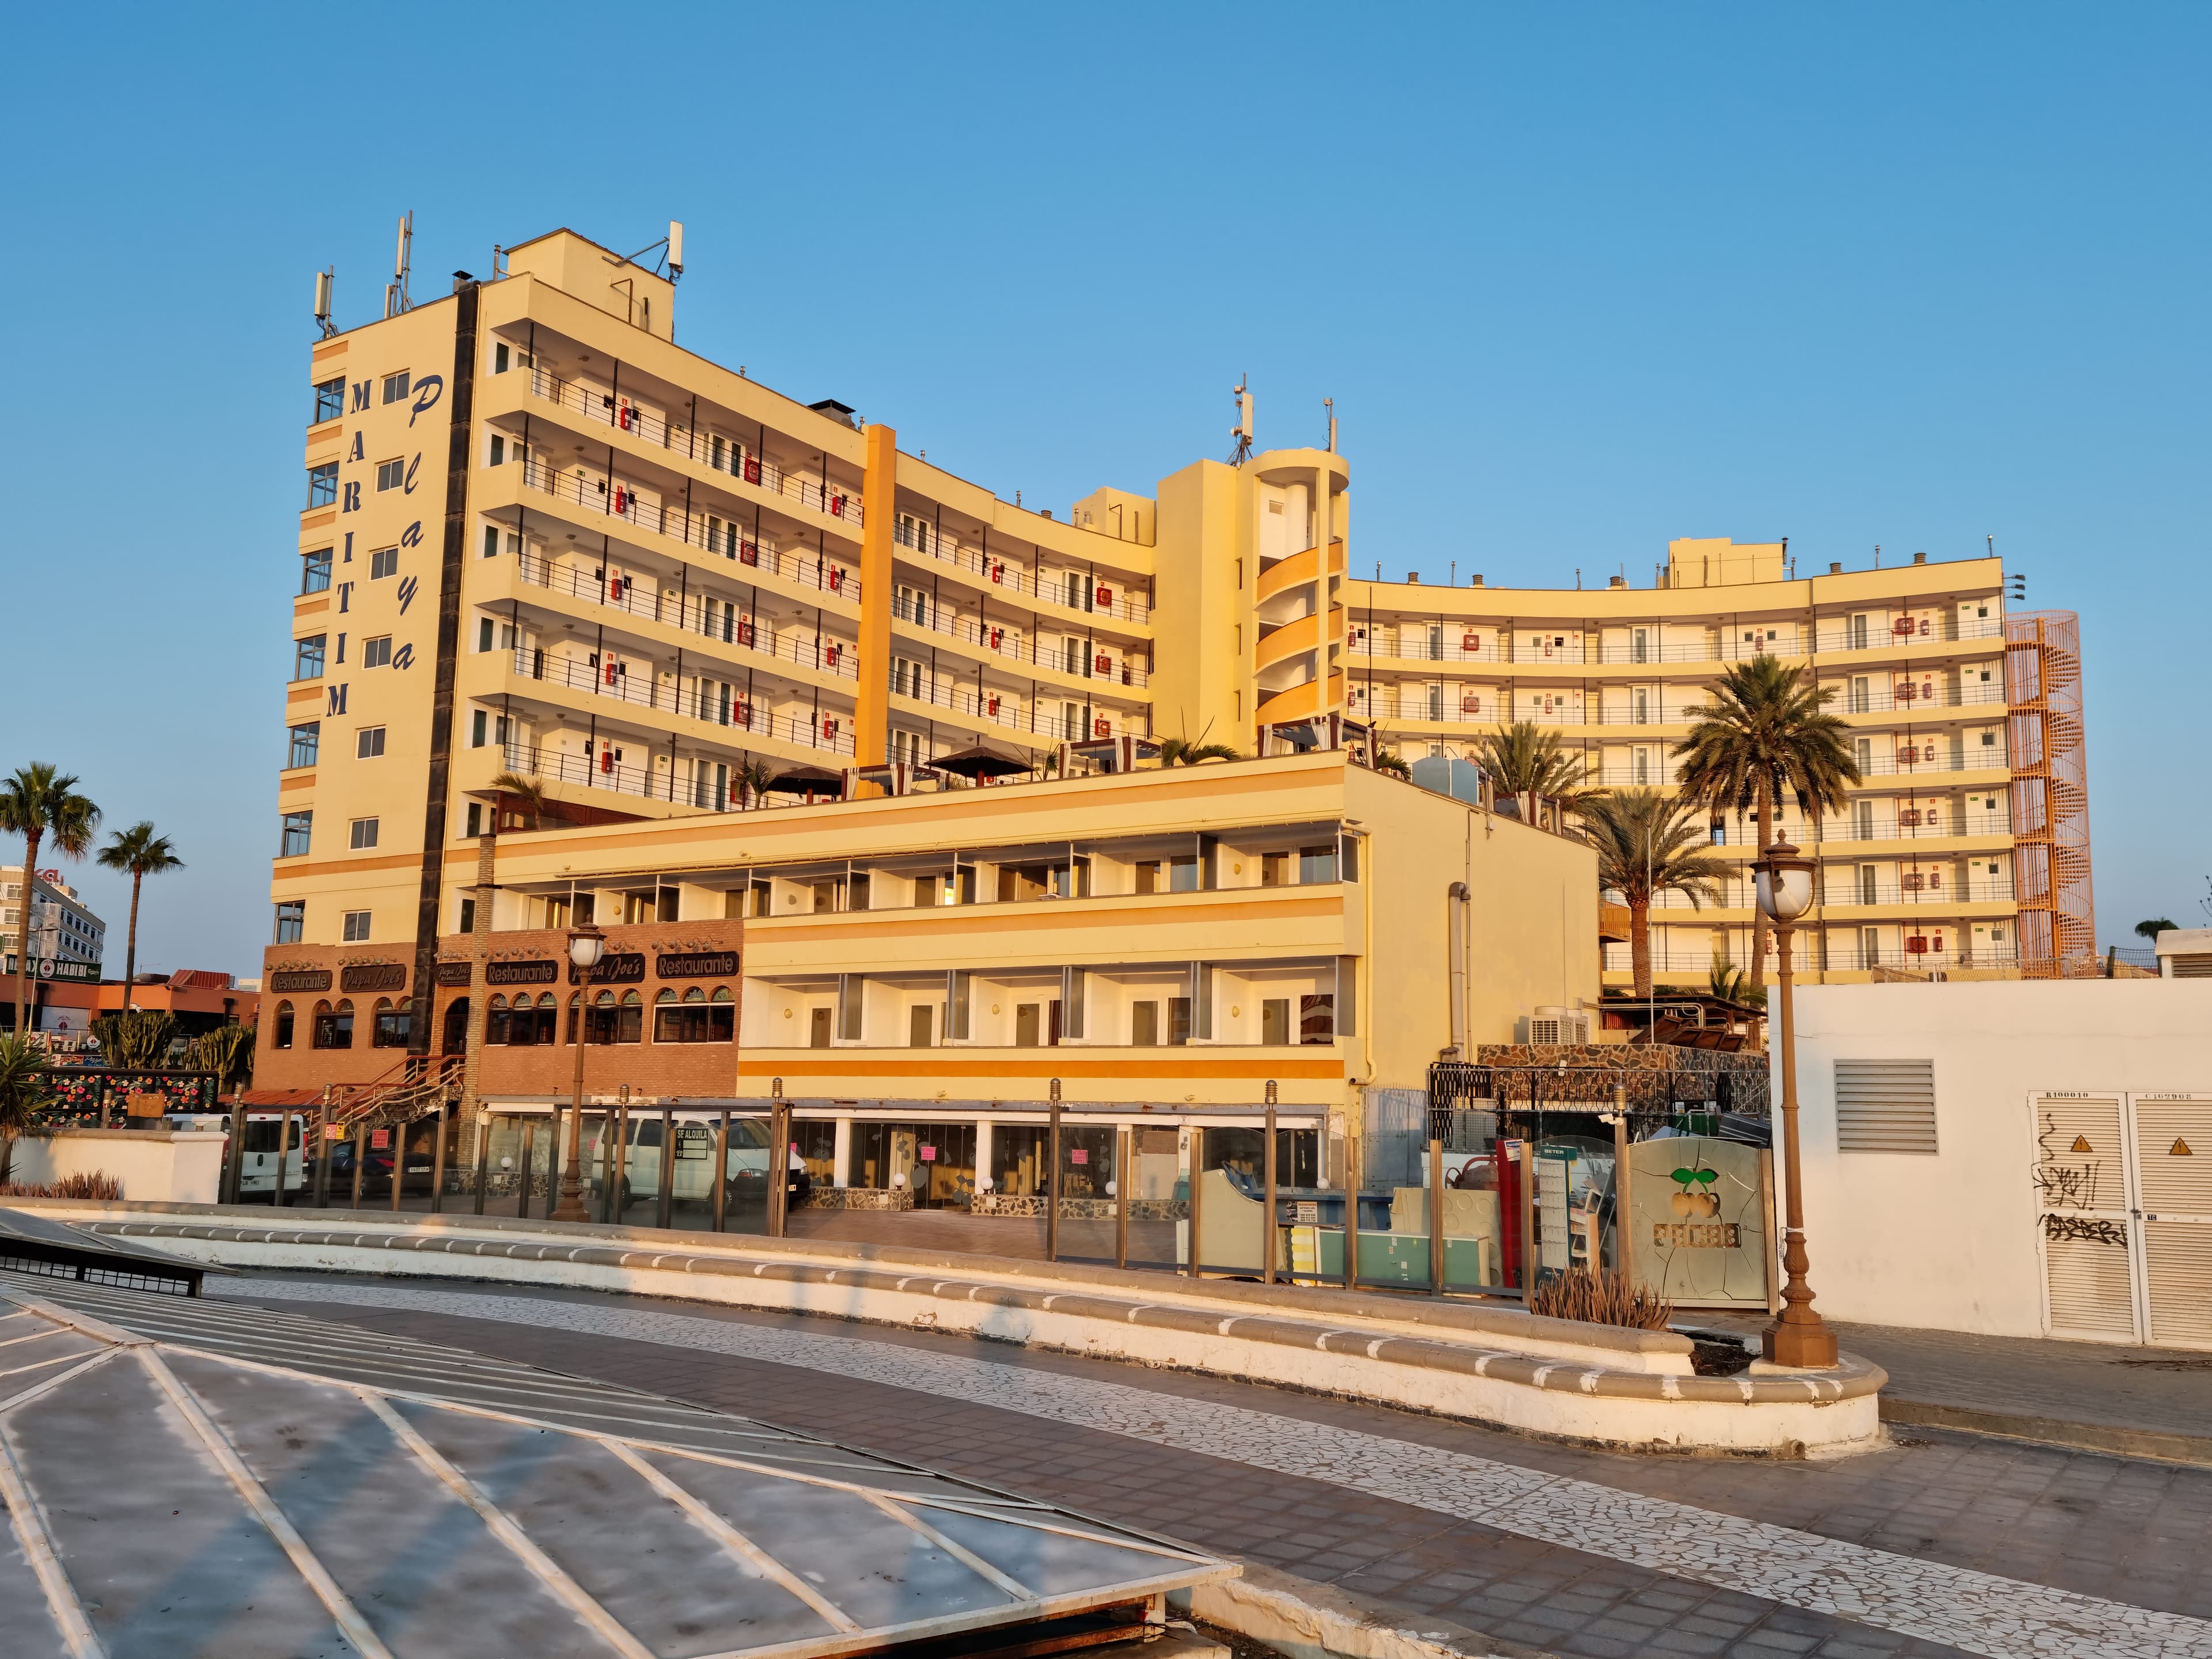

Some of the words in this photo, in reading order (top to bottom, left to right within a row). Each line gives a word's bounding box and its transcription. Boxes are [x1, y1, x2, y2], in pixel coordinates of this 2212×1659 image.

[392, 374, 444, 671] Playa
[326, 378, 373, 718] MARITIM
[56, 963, 88, 978] HABIBI
[488, 964, 552, 982] Restaurante
[608, 956, 640, 980] Joe's
[659, 955, 733, 975] Restaurante
[272, 974, 327, 990] Restaurante
[345, 969, 372, 988] Papa
[374, 968, 402, 988] Joe's
[677, 1130, 684, 1138] SE
[685, 1130, 707, 1139] ALQUILA
